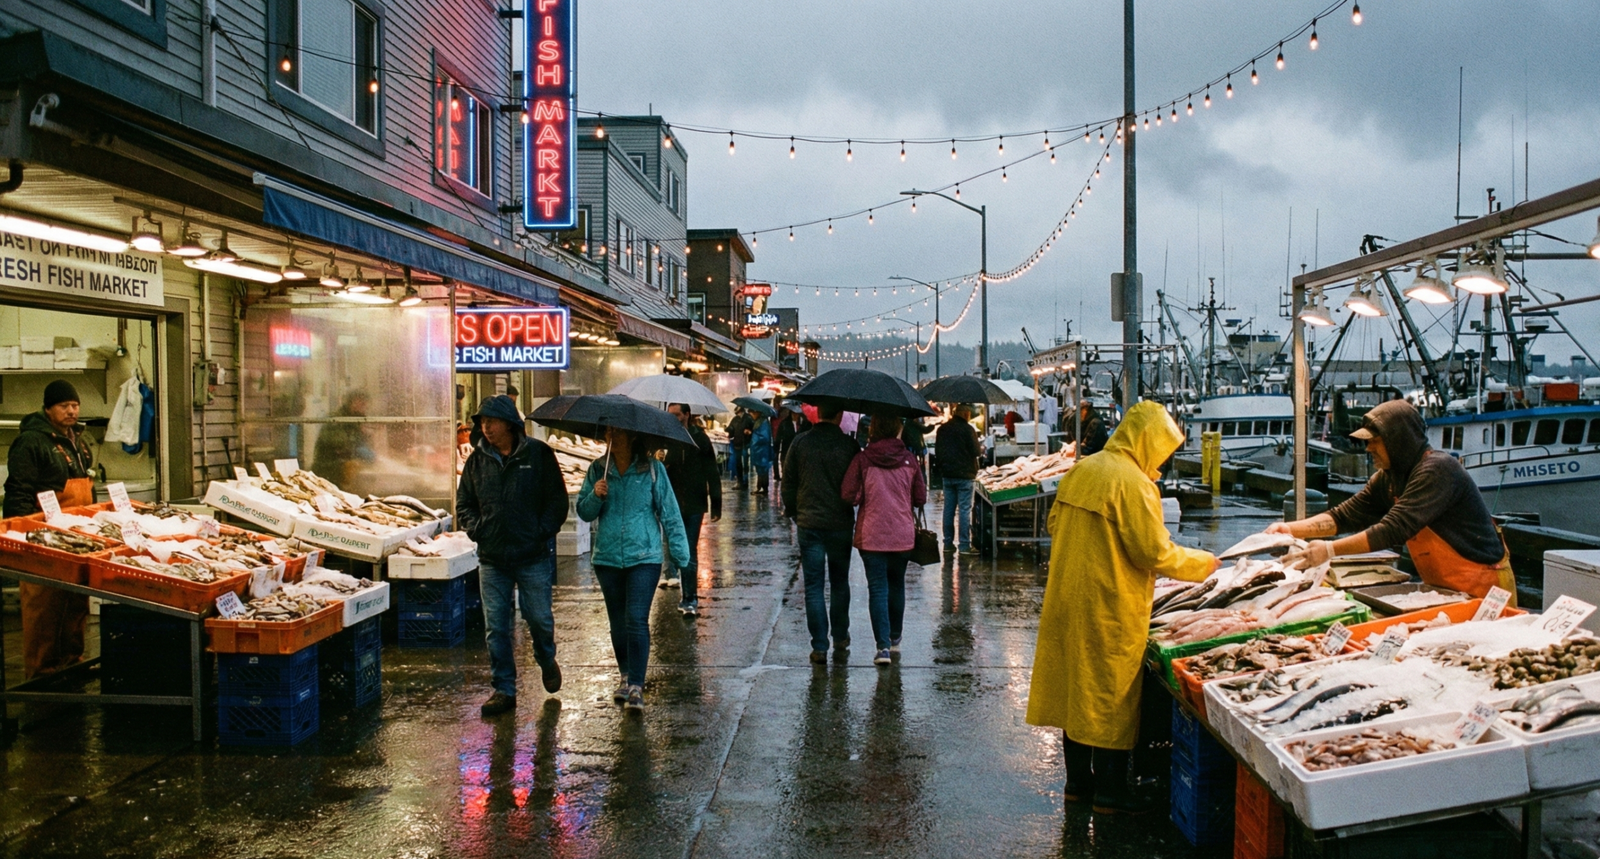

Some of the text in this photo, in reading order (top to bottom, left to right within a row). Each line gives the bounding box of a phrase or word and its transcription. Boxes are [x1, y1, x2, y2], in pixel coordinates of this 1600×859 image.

[534, 100, 564, 218] MARKT
[0, 256, 149, 298] ESH FISH MARKET
[487, 314, 562, 344] OPEN
[463, 346, 496, 363] FISH
[501, 345, 563, 363] MARKET
[1513, 460, 1581, 478] MHSETO
